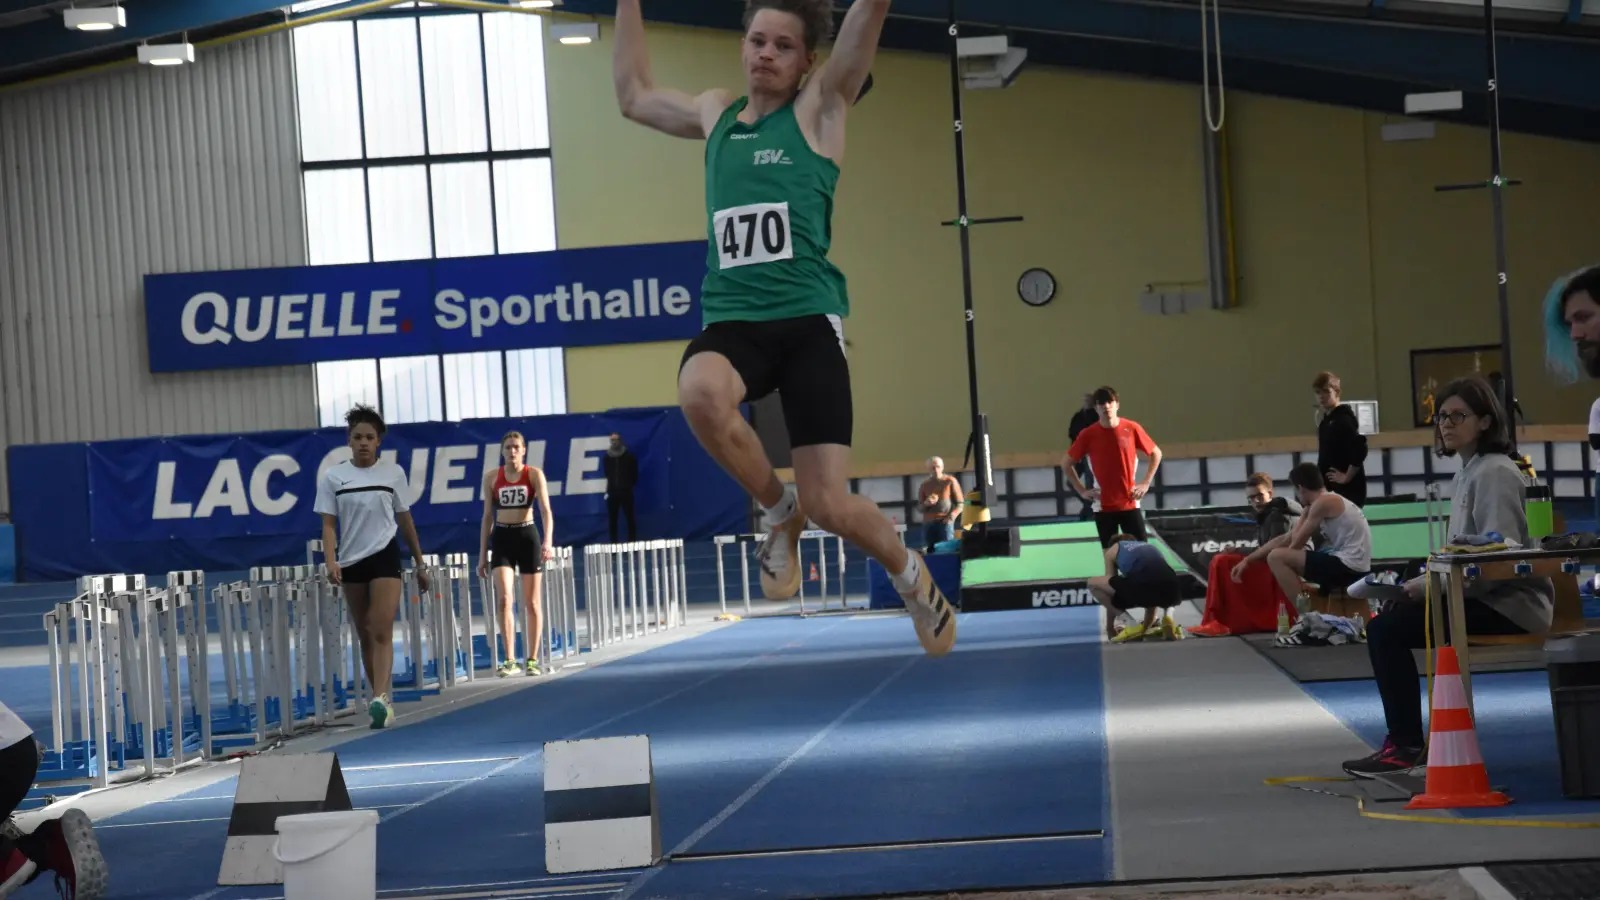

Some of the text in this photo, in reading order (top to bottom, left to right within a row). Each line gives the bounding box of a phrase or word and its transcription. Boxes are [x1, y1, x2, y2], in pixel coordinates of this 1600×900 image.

[948, 24, 957, 36] 6
[1488, 79, 1496, 91] 5
[954, 120, 962, 131] 5
[753, 149, 784, 165] TSV
[1493, 175, 1502, 187] 4
[959, 215, 968, 227] 4
[723, 210, 785, 259] 470
[1498, 272, 1507, 284] 3
[434, 277, 691, 338] Sporthalle
[965, 310, 974, 321] 3
[152, 454, 301, 520] LAC
[501, 488, 526, 505] 575
[1032, 588, 1099, 607] venn
